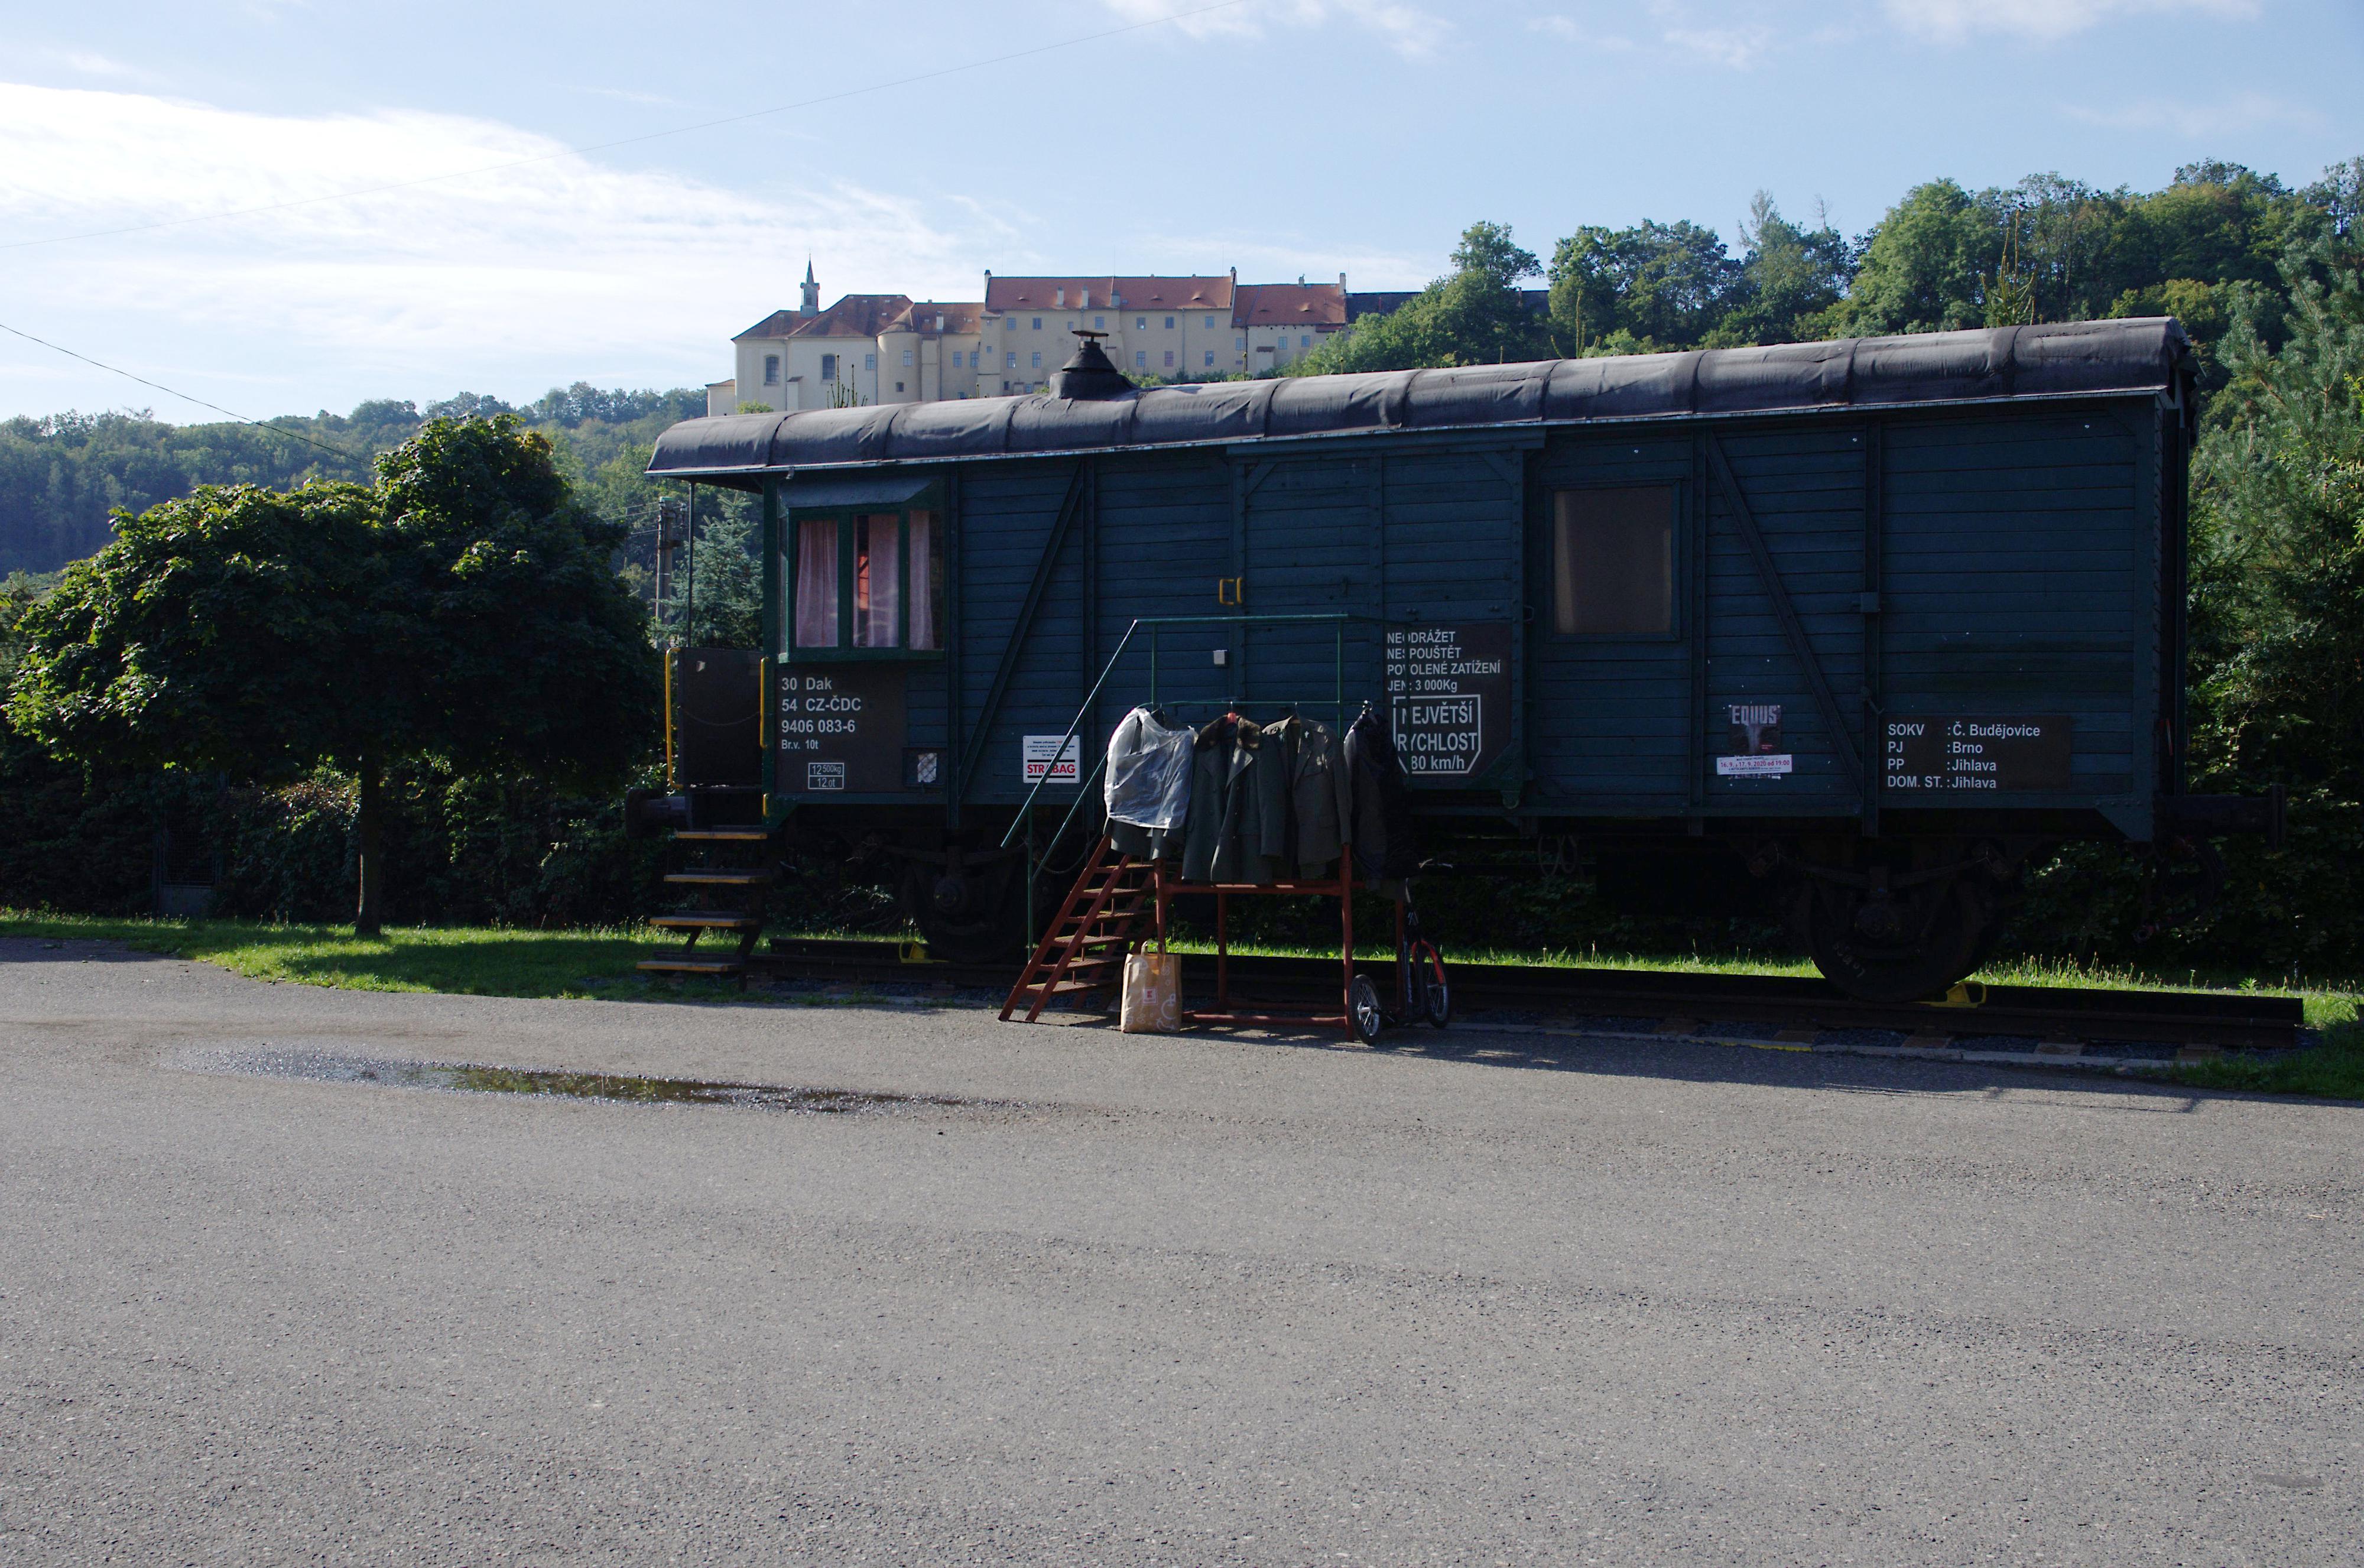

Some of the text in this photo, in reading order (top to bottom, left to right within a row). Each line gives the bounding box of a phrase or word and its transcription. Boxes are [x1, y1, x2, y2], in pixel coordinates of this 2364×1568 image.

[1450, 659, 1501, 674] ZATÍŽENÍ
[781, 677, 832, 690] 30 Dak
[1415, 680, 1421, 691] 3
[1424, 679, 1458, 693] 000Kg
[781, 694, 862, 712] 54 CZ-ČDC
[1732, 705, 1777, 726] EQUUS
[781, 719, 856, 733] 9406 083-6
[1888, 723, 1924, 736] SOKV
[1970, 723, 2040, 739] Budějovice
[781, 739, 819, 749] Br.v. 10t
[1888, 741, 1903, 754] PJ
[1027, 764, 1076, 774] STRBAG
[1411, 754, 1464, 770] 80 km/h
[1888, 758, 1905, 770] PP
[1888, 775, 1920, 788] DOM.
[1925, 775, 1943, 788] ST.
